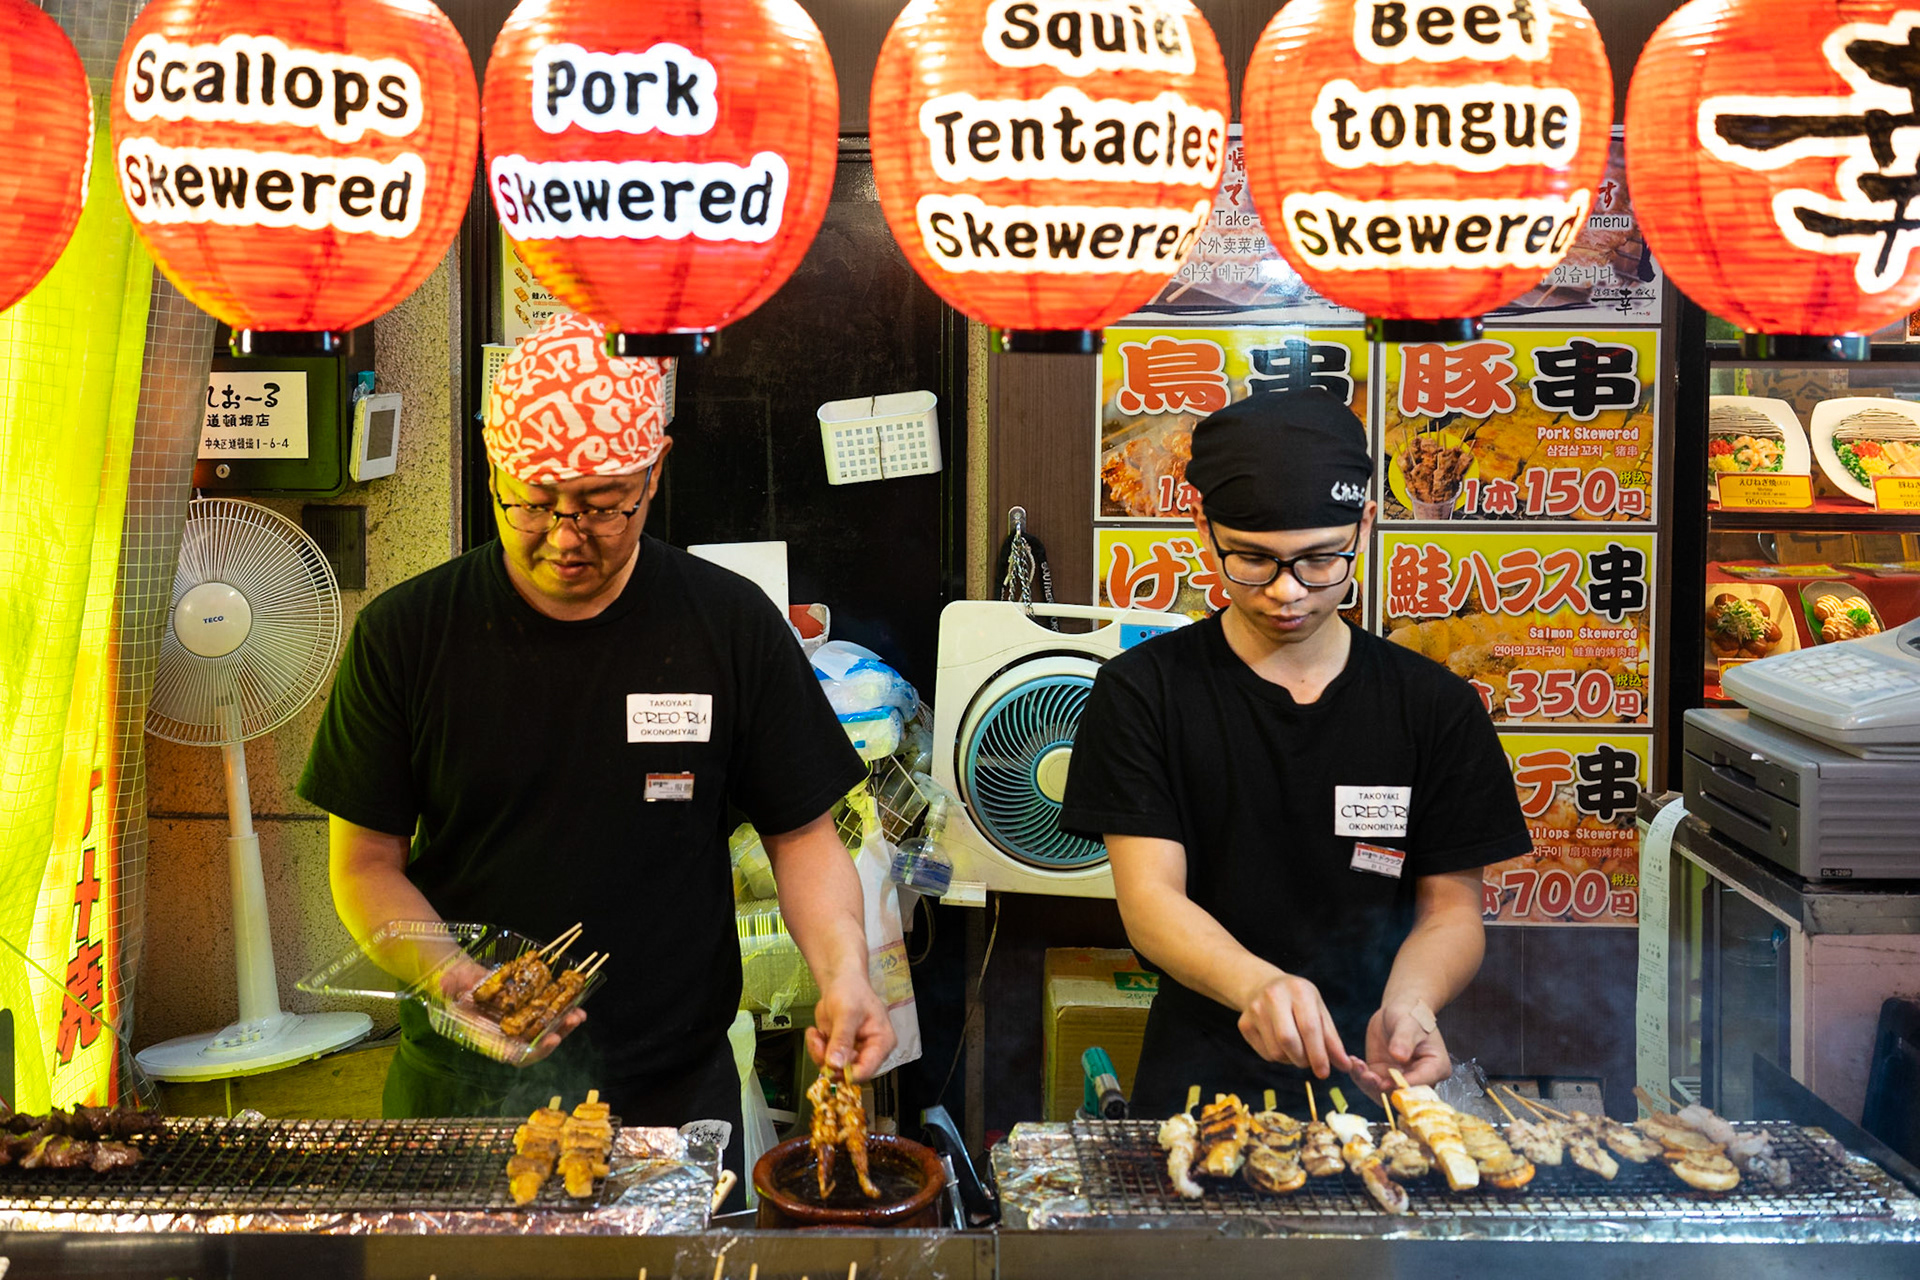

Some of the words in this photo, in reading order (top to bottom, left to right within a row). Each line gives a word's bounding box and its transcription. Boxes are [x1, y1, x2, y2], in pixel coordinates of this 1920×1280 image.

[1371, 0, 1535, 47] Beef
[133, 50, 408, 125] Scallops
[547, 60, 699, 116] Pork
[935, 107, 1218, 172] Tentacles
[1329, 98, 1568, 154] tongue
[126, 154, 411, 221] Skewered
[499, 171, 773, 226] Skewered
[930, 212, 1202, 261] Skewered
[1215, 210, 1263, 226] Take-
[1590, 215, 1629, 228] menu
[1295, 206, 1580, 255] Skewered
[1174, 263, 1211, 282] 아웃
[206, 413, 270, 428] 道頓堀店
[1537, 426, 1570, 440] Pork
[1574, 427, 1639, 440] Skewered
[1466, 479, 1518, 515] 1本
[1390, 543, 1644, 620] 鮭ハラス串
[203, 615, 224, 624] TECO
[1530, 627, 1574, 640] Salmon
[1579, 627, 1638, 640] Skewered
[650, 699, 692, 707] TAKOYAKI
[641, 728, 698, 736] OKONOMIYAKI
[1359, 792, 1399, 800] TAKOYAKI
[1516, 745, 1639, 820] テ串
[1529, 828, 1570, 840] allops
[1576, 828, 1633, 840] Skewered
[1531, 846, 1561, 857] 치구이
